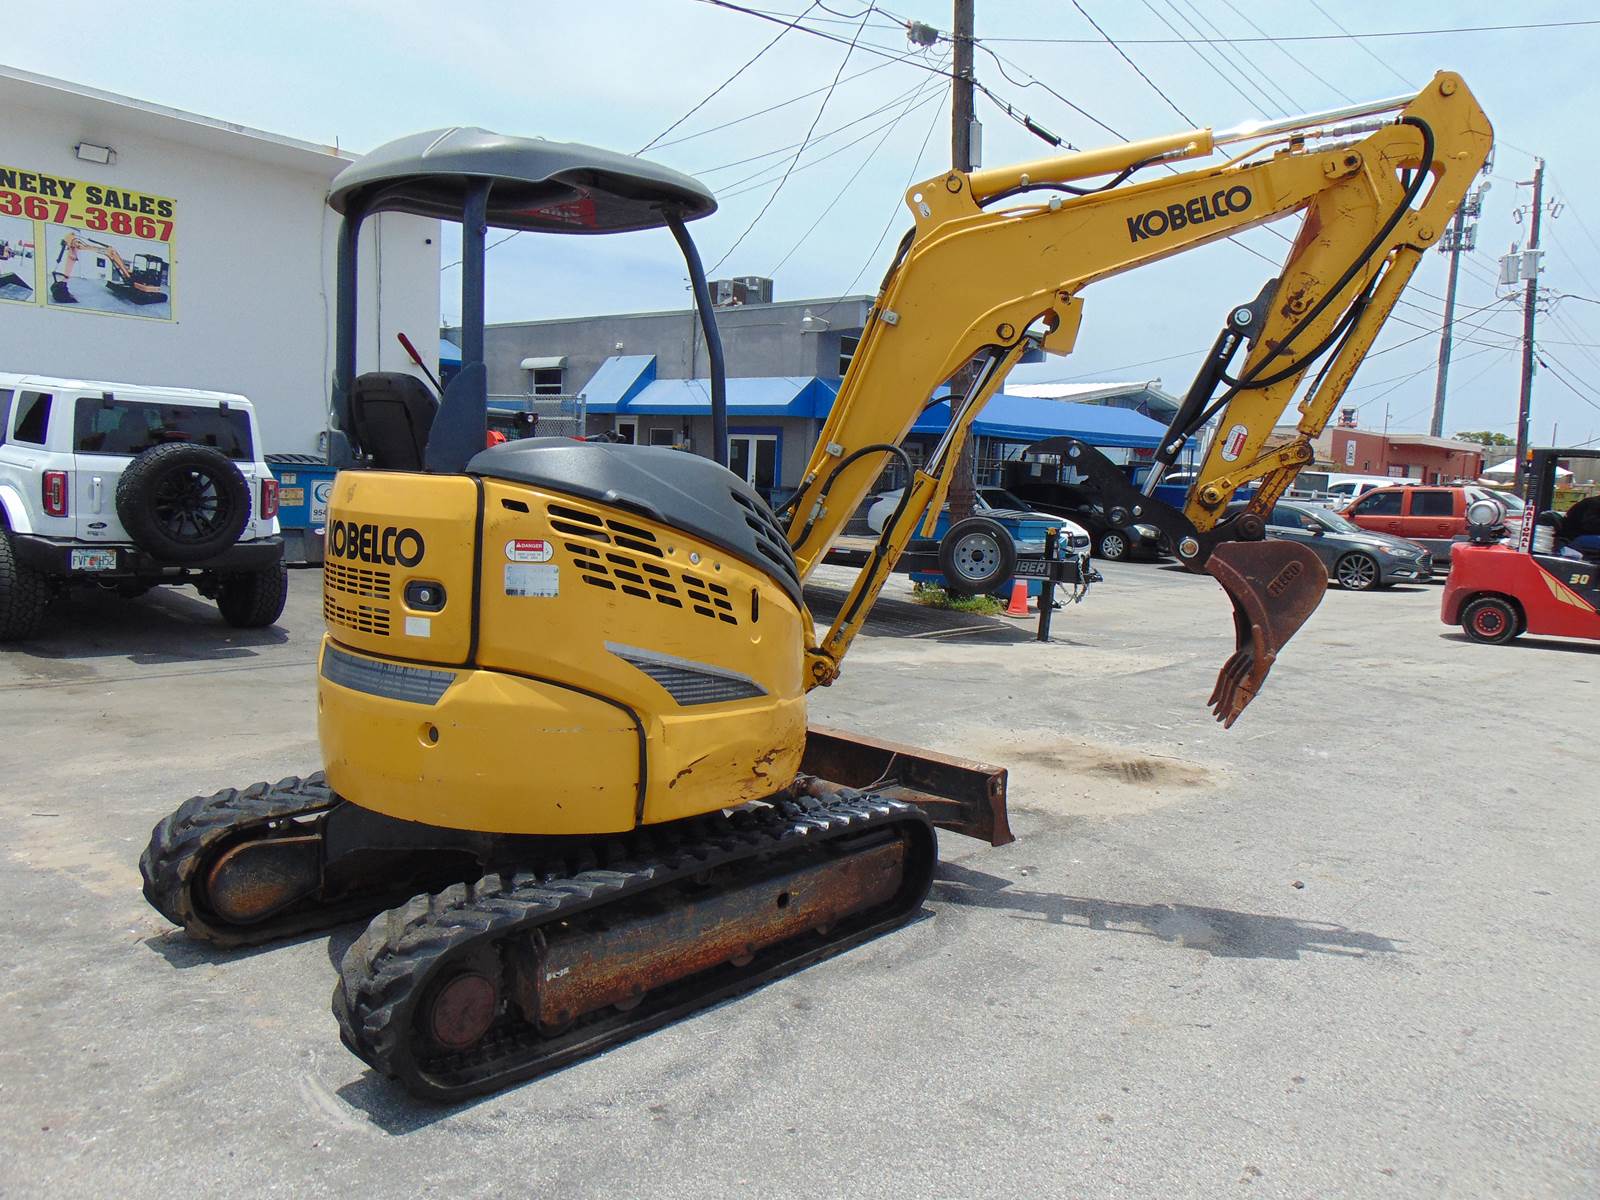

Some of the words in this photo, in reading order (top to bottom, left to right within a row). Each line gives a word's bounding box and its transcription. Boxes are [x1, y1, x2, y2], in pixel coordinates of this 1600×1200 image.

[0, 191, 173, 241] 367-3867
[86, 186, 173, 217] SALES
[1127, 185, 1252, 242] KOBELCO
[328, 519, 425, 567] KOBELCO
[1569, 573, 1590, 585] 30
